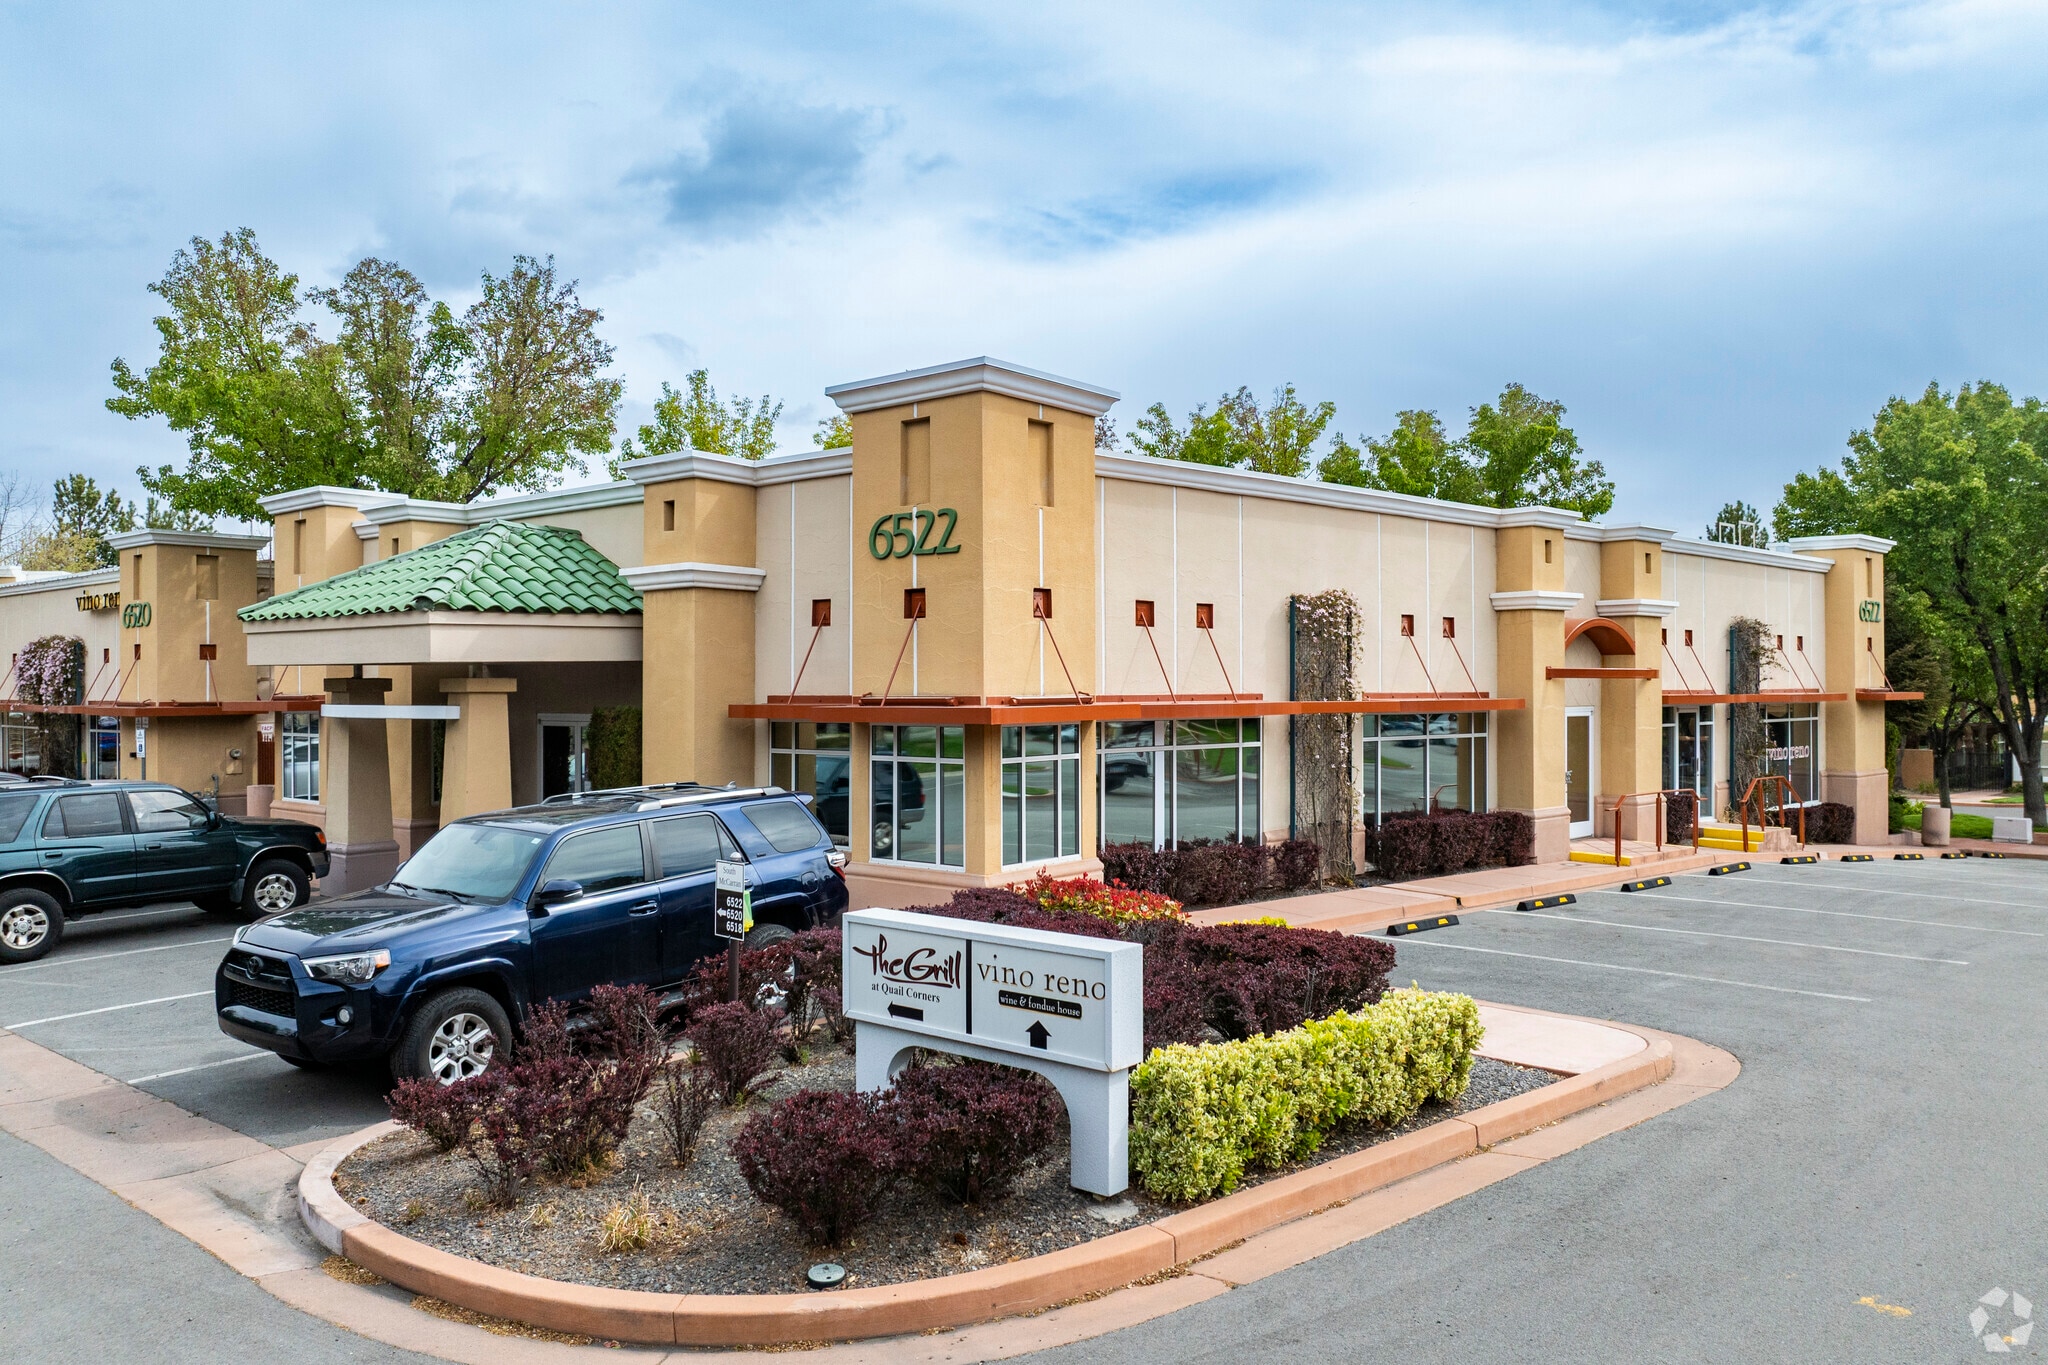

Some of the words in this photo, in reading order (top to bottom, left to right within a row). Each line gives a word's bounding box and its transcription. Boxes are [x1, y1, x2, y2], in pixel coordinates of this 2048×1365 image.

[869, 508, 961, 560] 6522
[76, 590, 100, 612] vino
[1859, 600, 1882, 623] 6522
[123, 602, 152, 629] 6520
[1767, 746, 1789, 761] vino
[1789, 745, 1810, 760] reno
[723, 866, 736, 875] South
[726, 896, 743, 909] 6522
[726, 909, 743, 921] 6520
[726, 921, 743, 934] 6518
[977, 954, 1034, 988] vino
[1044, 973, 1106, 1001] reno
[871, 983, 879, 991] at
[881, 983, 904, 996] Quail
[906, 987, 941, 1003] Corners
[1000, 994, 1018, 1006] wine
[1019, 996, 1027, 1007] &
[1028, 996, 1056, 1012] fondue
[1057, 1001, 1081, 1017] house
